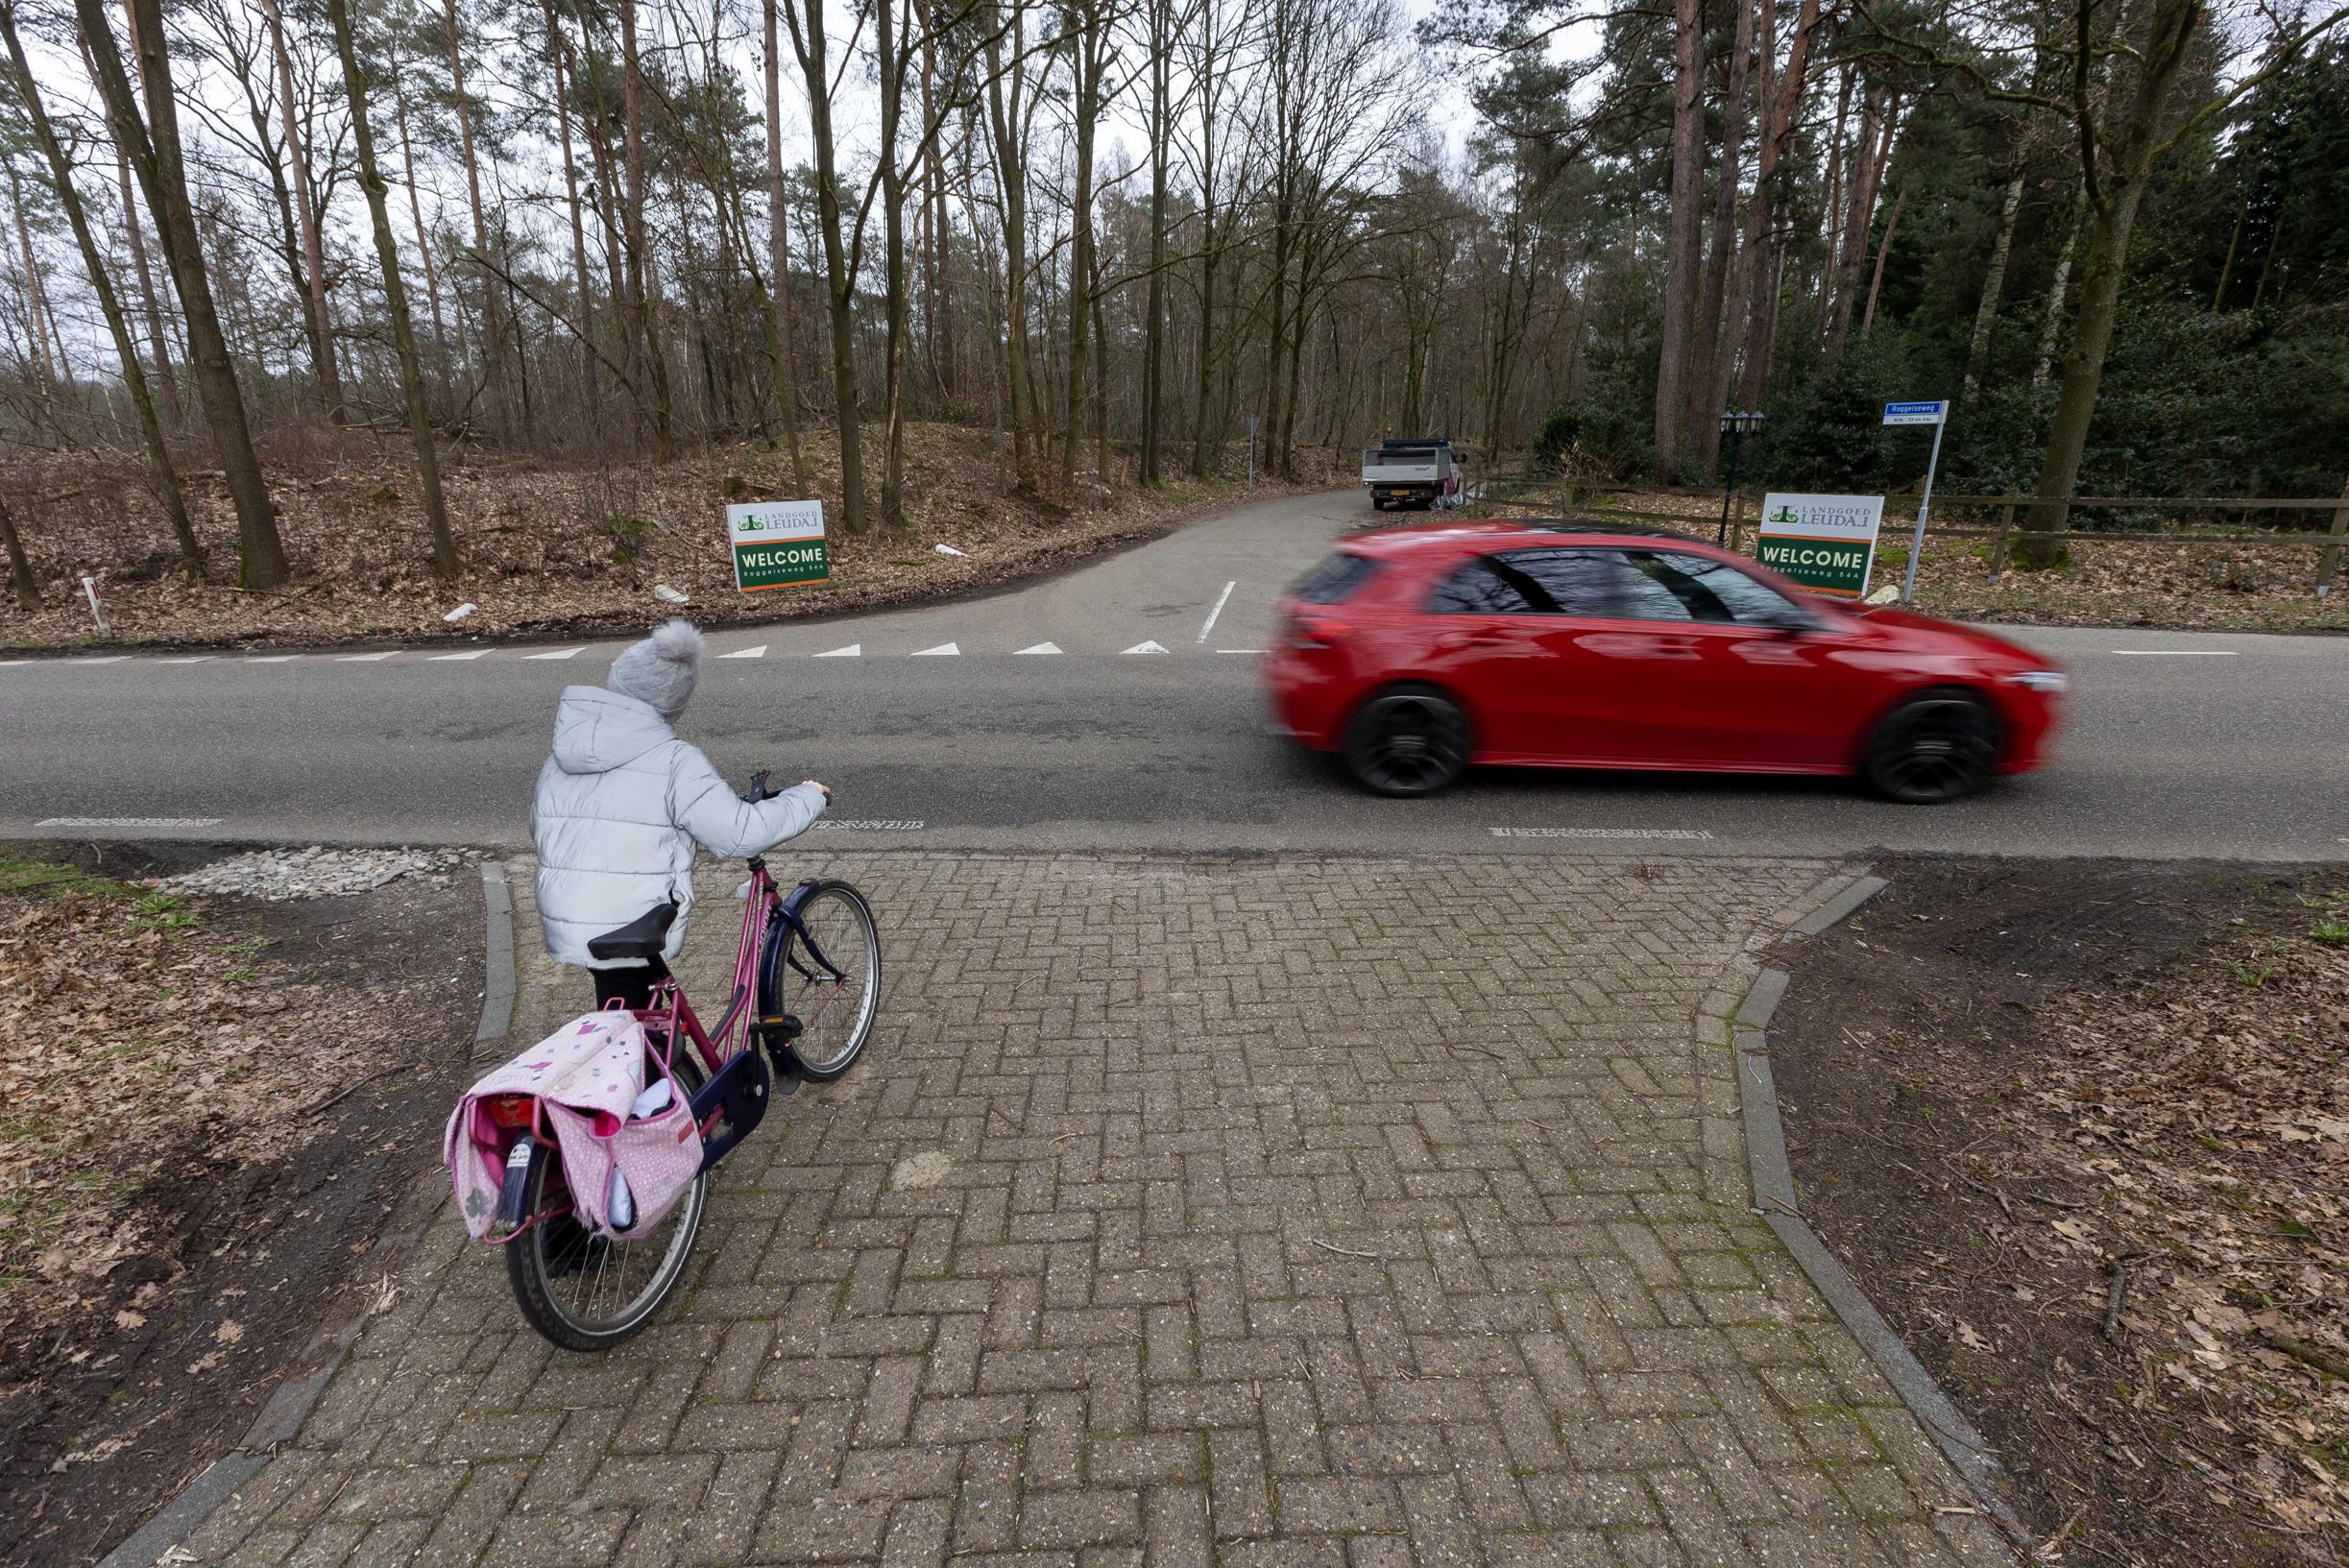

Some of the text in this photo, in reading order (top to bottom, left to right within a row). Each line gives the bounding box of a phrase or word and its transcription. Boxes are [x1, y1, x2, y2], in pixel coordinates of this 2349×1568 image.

[764, 511, 817, 520] LANDGOED
[1802, 506, 1871, 516] LANDGOED
[741, 548, 823, 567] WELCOME
[1763, 546, 1863, 568] WELCOME
